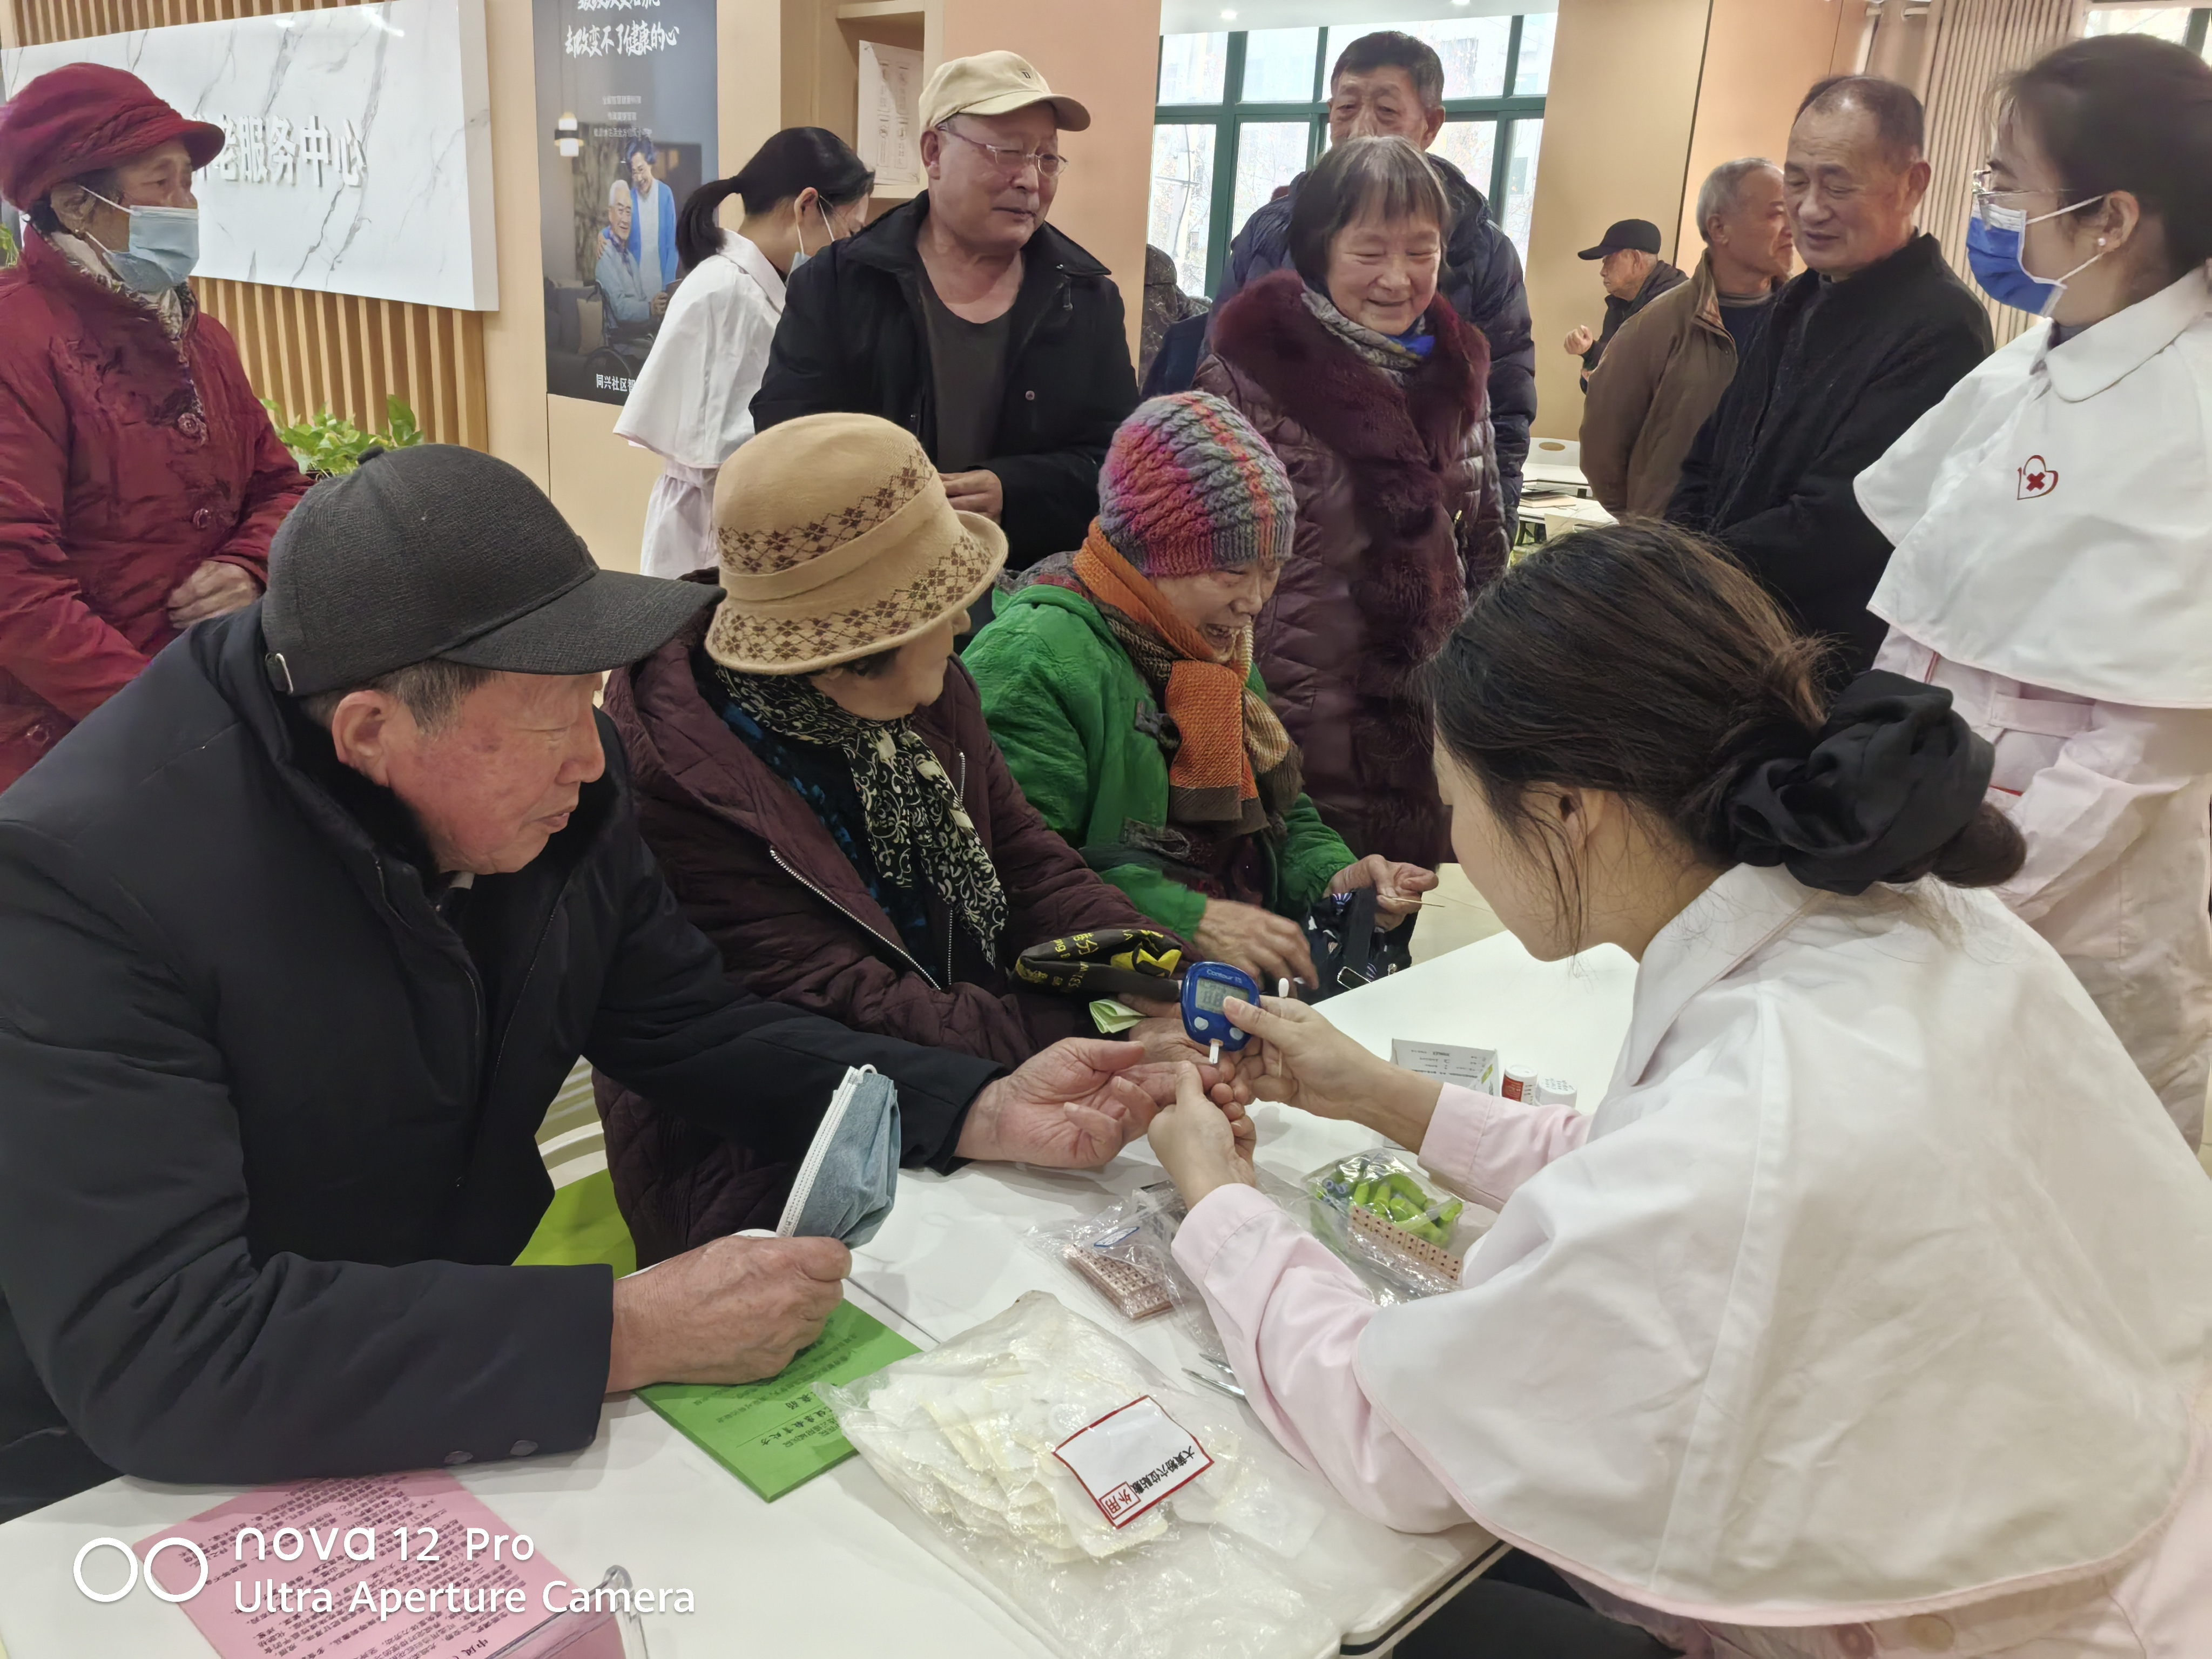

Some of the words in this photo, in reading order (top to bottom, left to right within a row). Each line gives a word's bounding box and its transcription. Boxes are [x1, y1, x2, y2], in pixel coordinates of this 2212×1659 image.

[565, 20, 679, 58] 却改变不了健康的心
[192, 113, 366, 186] 老服务中心
[1206, 969, 1233, 980] Contour
[1131, 1446, 1195, 1494] 大黄粉穴位贴敷
[1105, 1489, 1132, 1514] 外用
